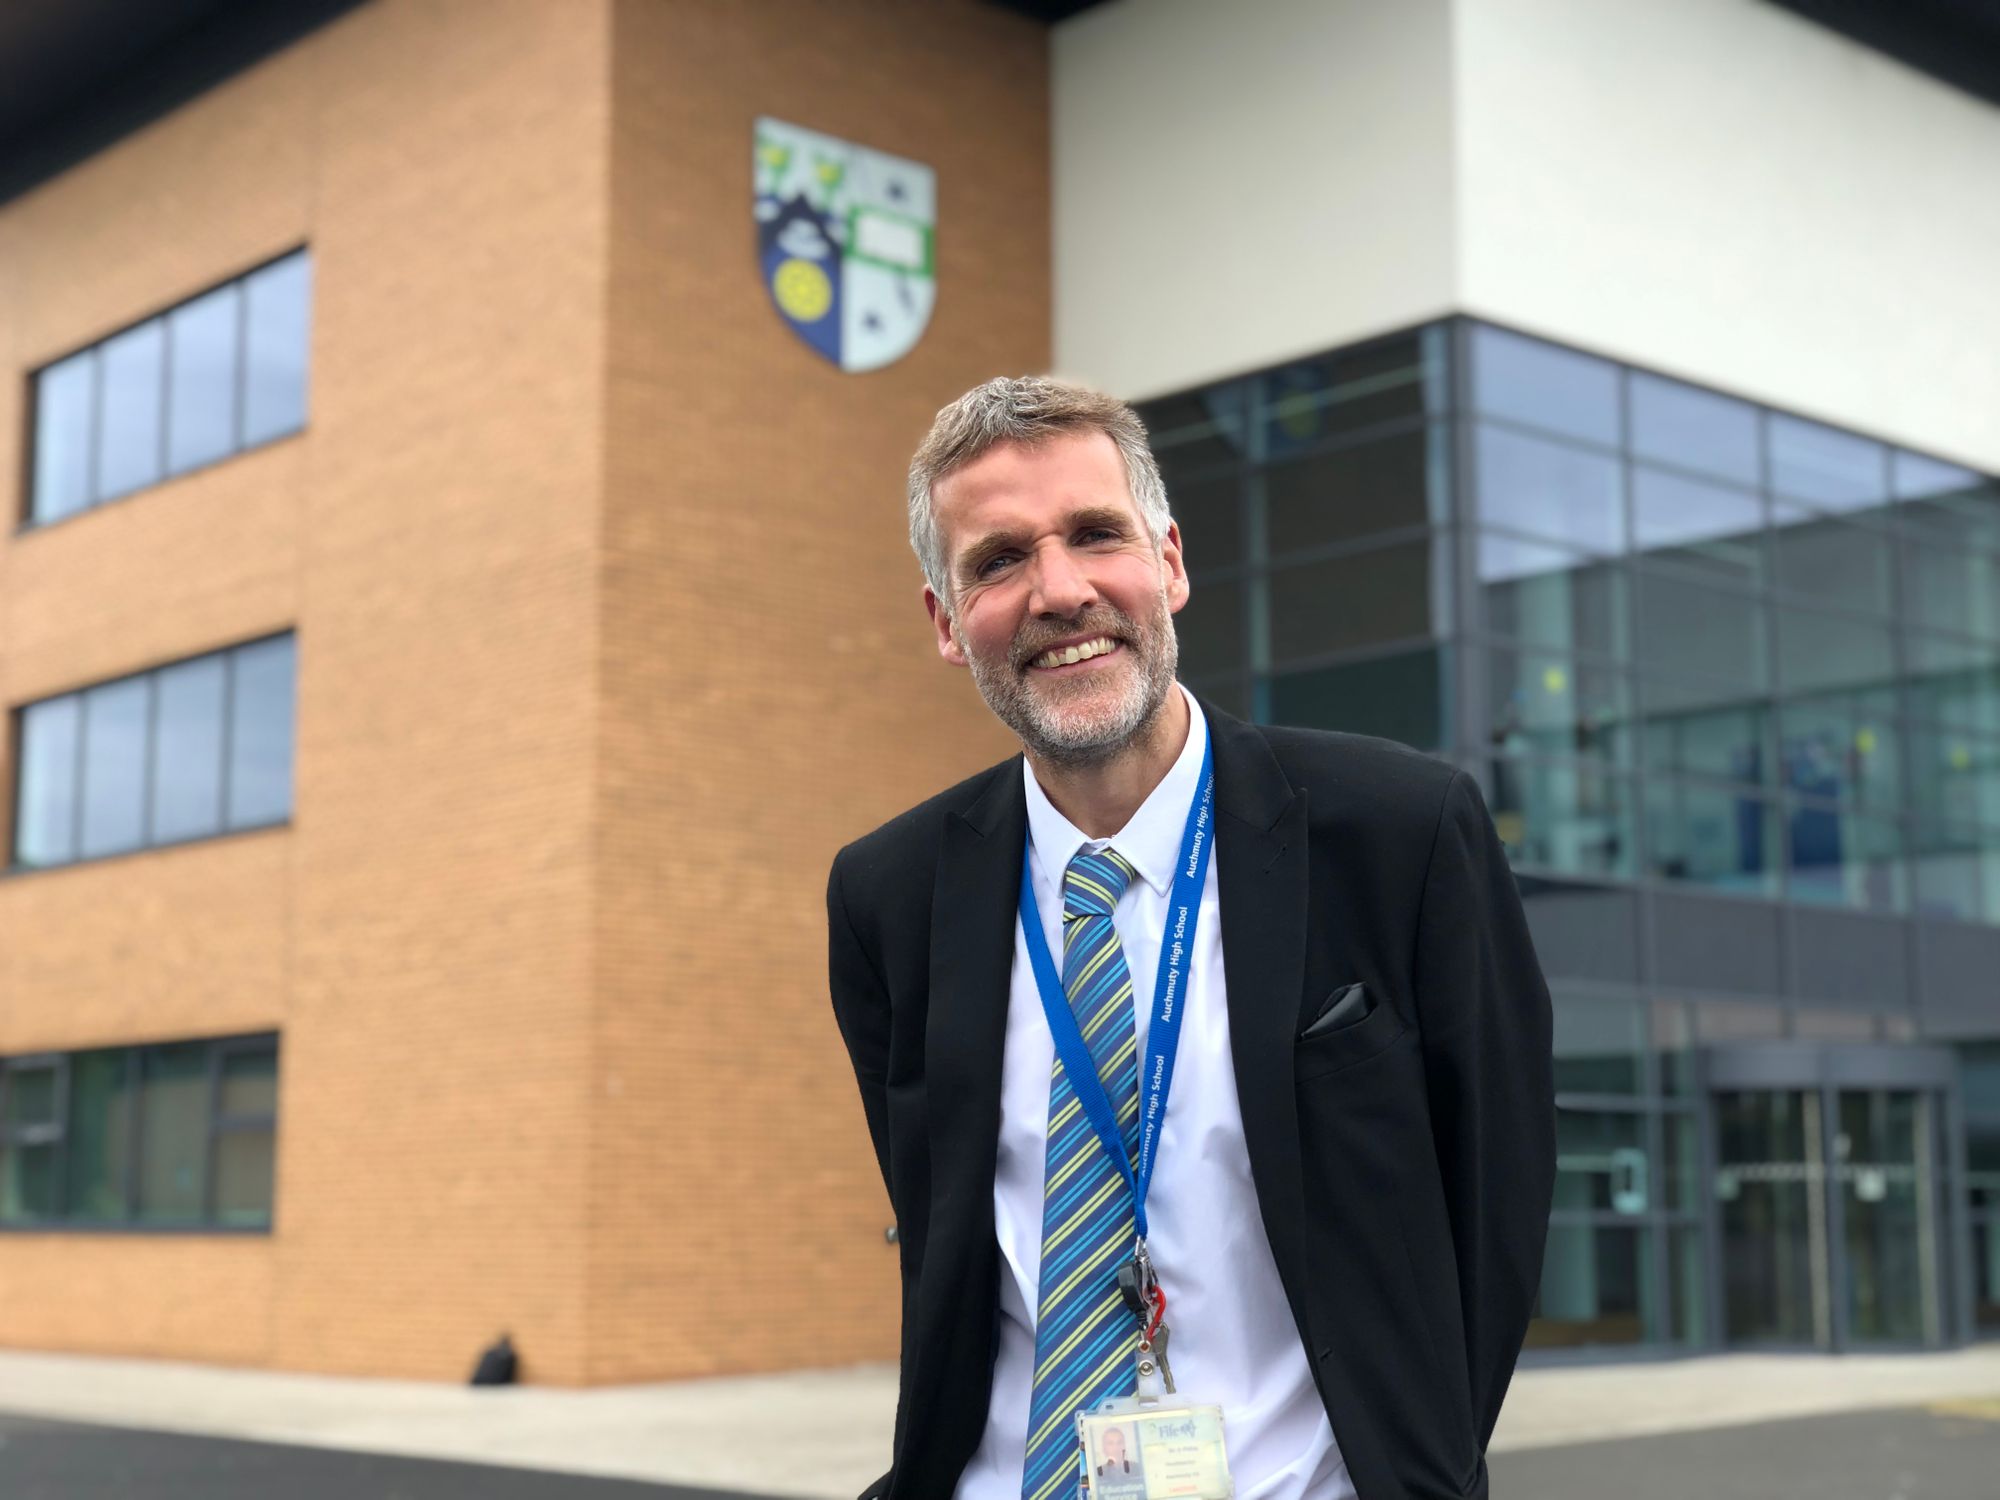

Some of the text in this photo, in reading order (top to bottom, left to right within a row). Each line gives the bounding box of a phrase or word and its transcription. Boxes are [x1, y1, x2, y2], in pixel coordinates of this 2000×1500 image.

[1186, 828, 1206, 878] Auchmuty
[1197, 805, 1209, 828] High
[1161, 906, 1188, 1022] Auchmuty High School
[1152, 1055, 1164, 1091] School
[1147, 1093, 1159, 1119] High
